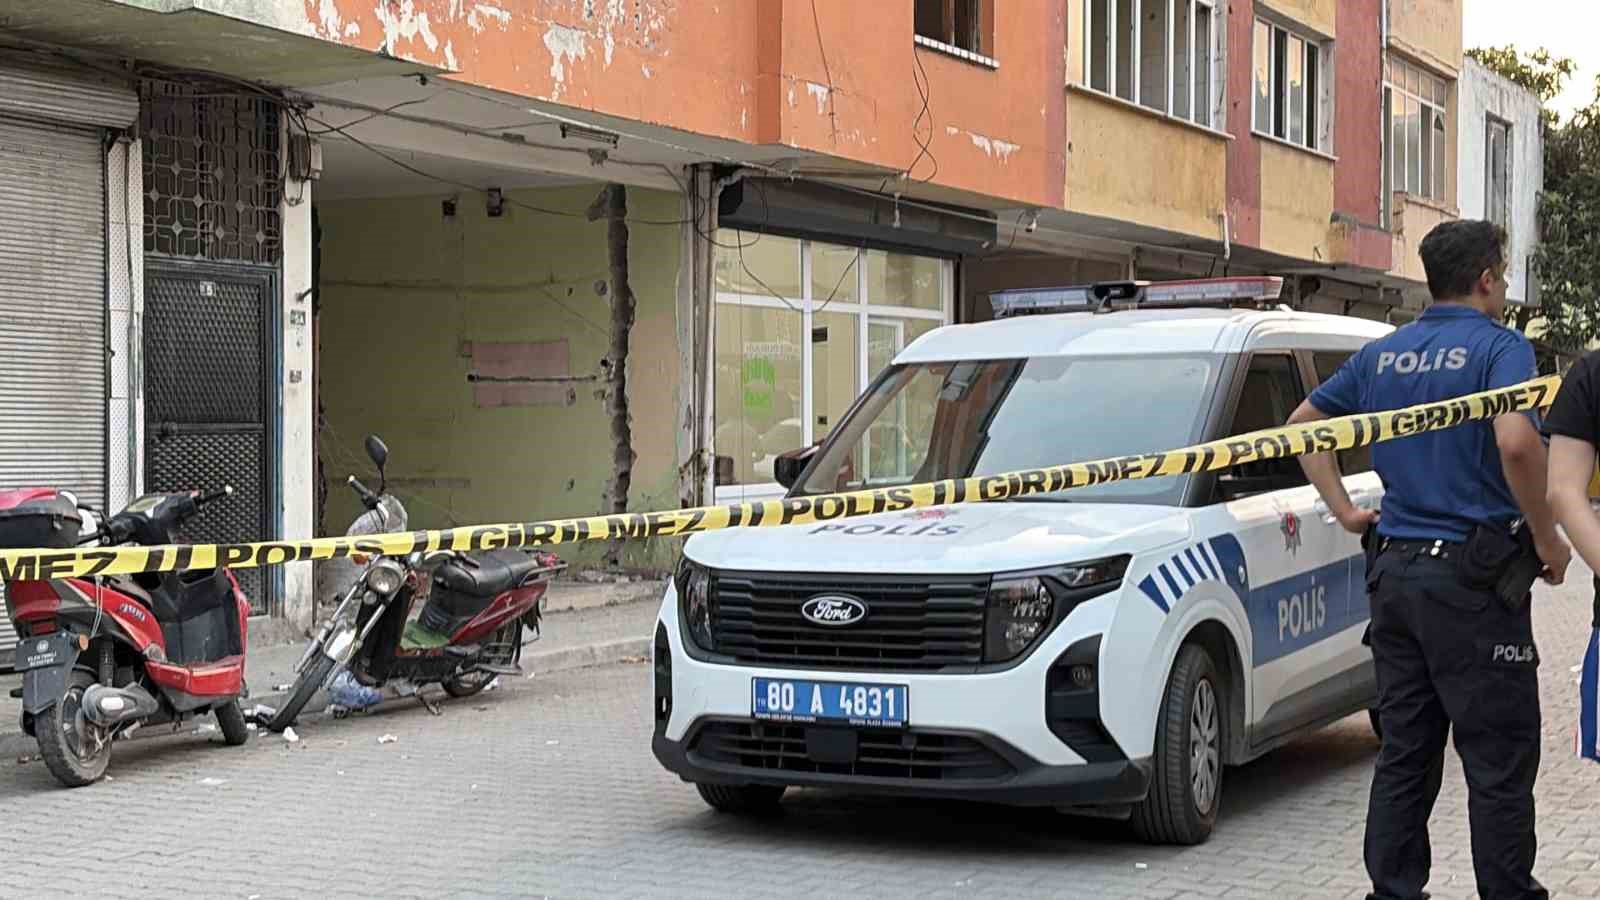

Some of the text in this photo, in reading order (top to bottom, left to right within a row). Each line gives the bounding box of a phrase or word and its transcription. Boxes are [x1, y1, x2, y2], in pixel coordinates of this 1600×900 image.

[1377, 347, 1468, 375] POLİS
[781, 488, 914, 524] POLİS
[1228, 427, 1337, 463] POLİS
[808, 521, 964, 537] POLİS
[813, 599, 852, 620] Ford
[1278, 575, 1326, 643] POLİS
[767, 682, 794, 711] 80
[810, 684, 824, 714] A
[839, 686, 894, 718] 4831
